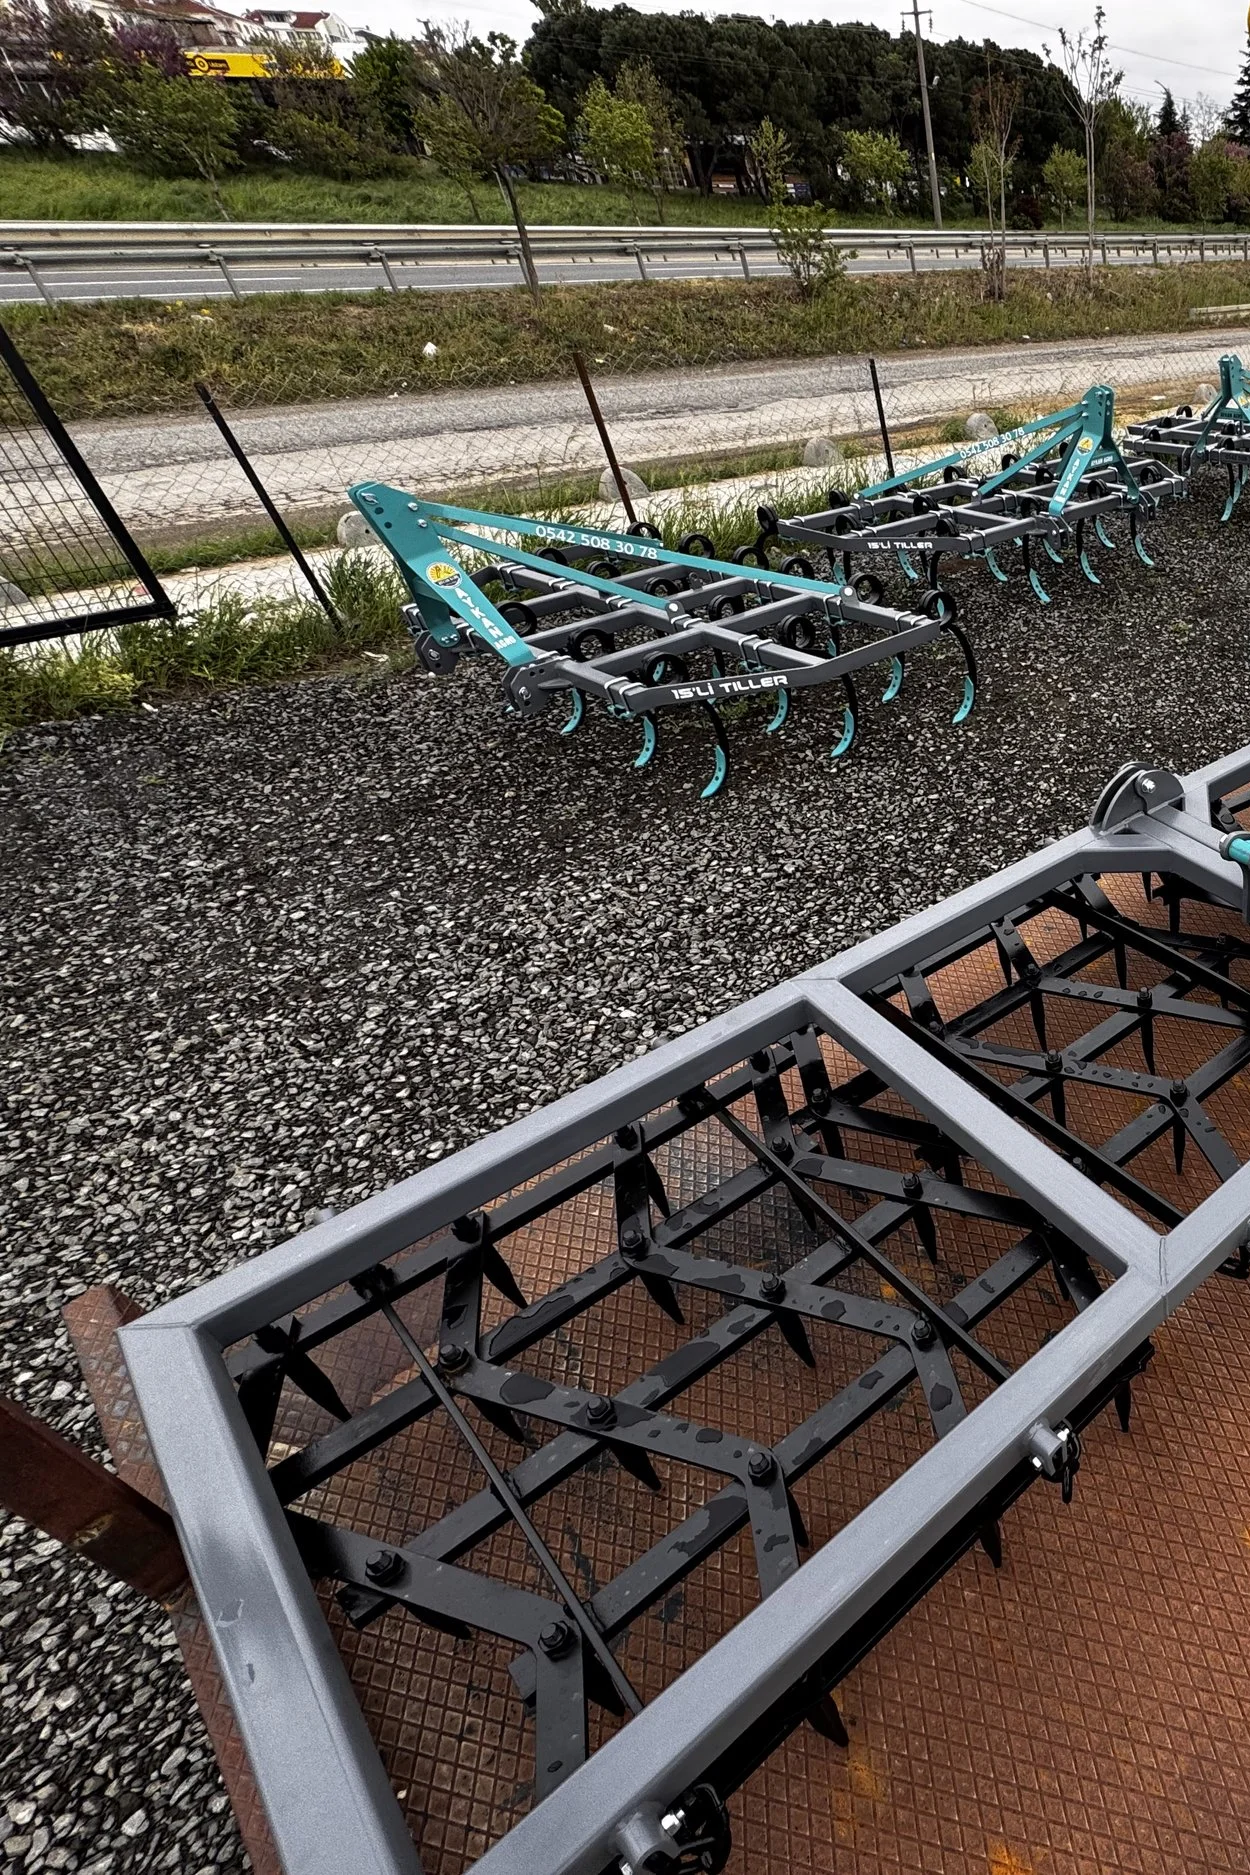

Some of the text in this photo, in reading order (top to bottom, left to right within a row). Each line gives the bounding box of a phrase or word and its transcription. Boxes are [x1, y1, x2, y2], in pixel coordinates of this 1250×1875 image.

[960, 426, 1025, 459] 0542 508 30 78
[1060, 458, 1080, 496] AYKAN
[535, 525, 658, 560] 0542 508 30 78
[454, 587, 504, 639] AYKAN
[719, 675, 789, 694] TILLER
